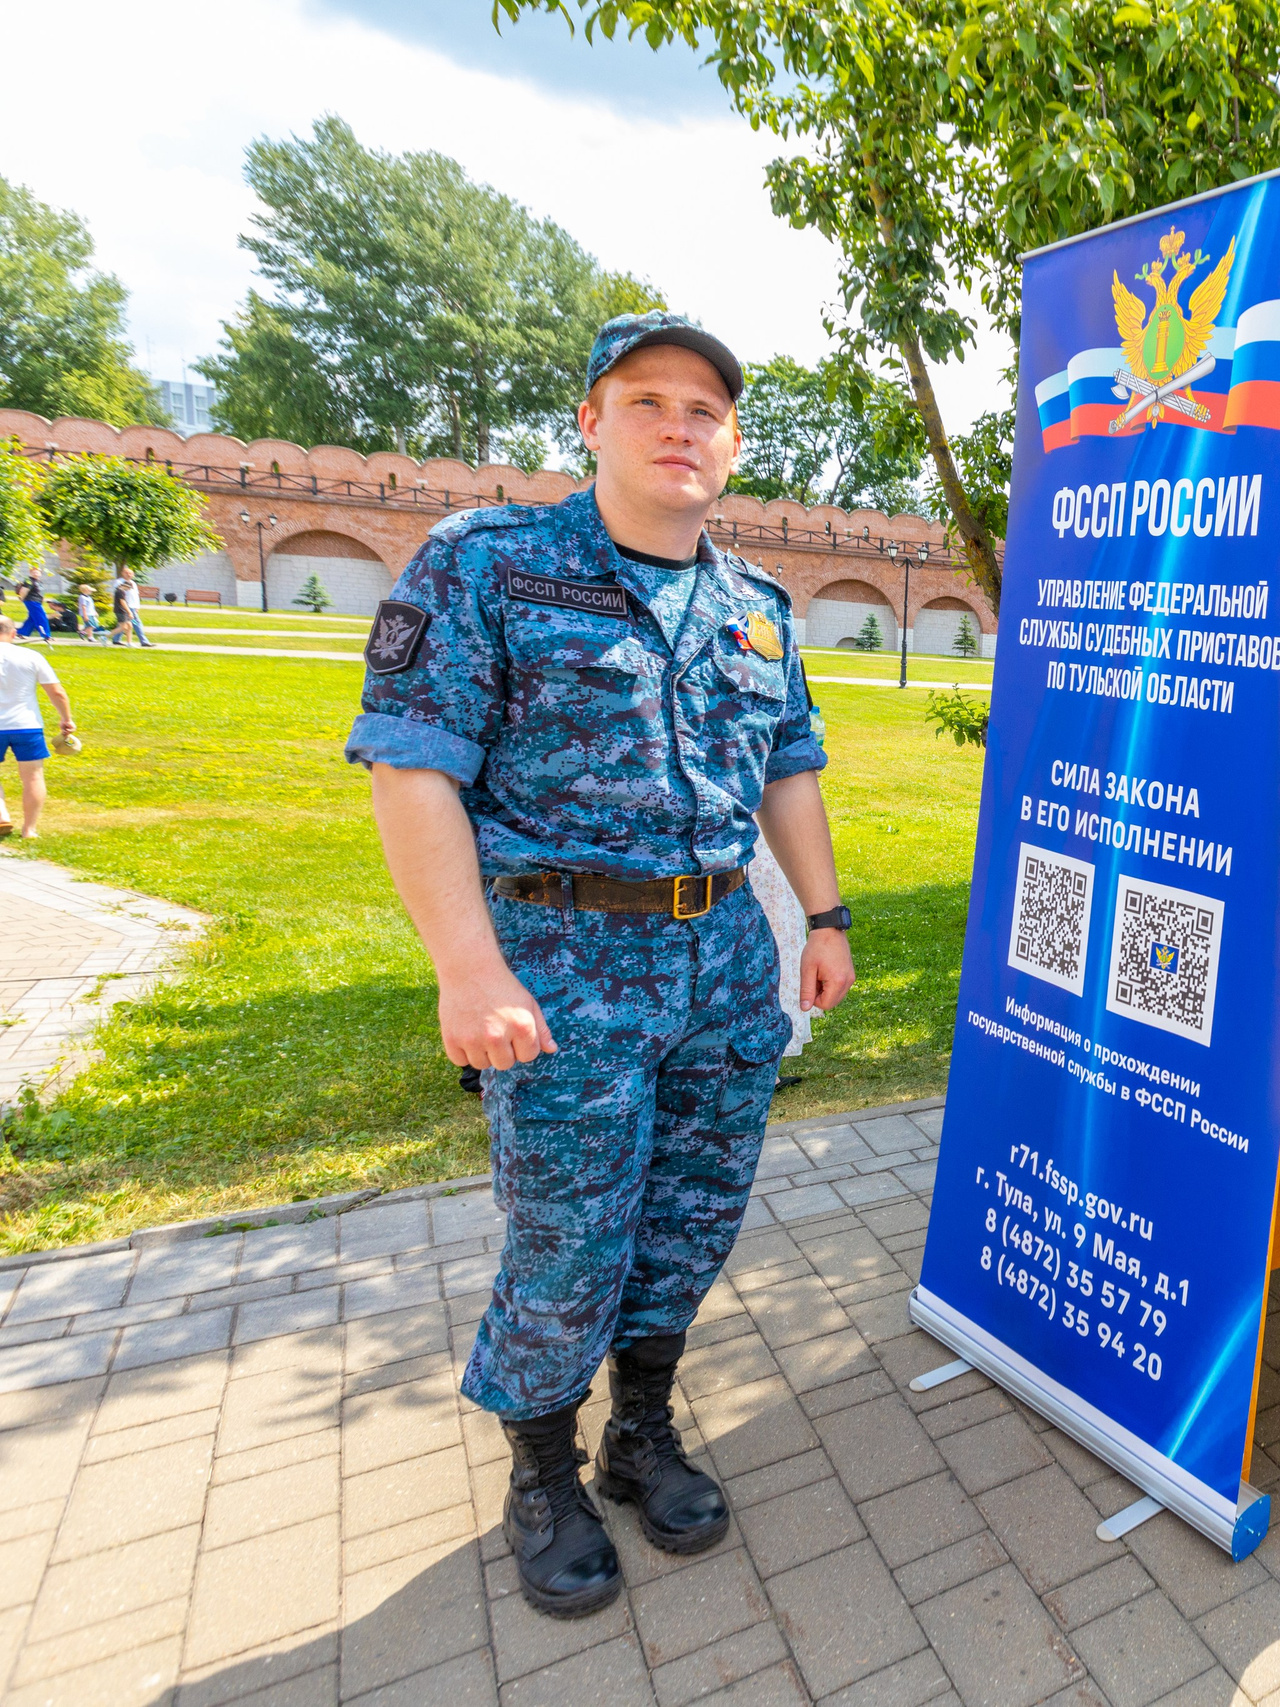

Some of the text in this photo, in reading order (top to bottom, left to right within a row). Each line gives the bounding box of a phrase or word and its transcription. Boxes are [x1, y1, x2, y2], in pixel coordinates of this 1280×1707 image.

[1052, 474, 1262, 539] ФССП РОССИИ
[512, 576, 623, 608] ФССП РОССИИ
[1037, 579, 1268, 620] УПРАВЛЕНИЕ ФЕДЕРАЛЬНОЙ
[1019, 617, 1083, 651] СЛУЖБЫ
[1085, 623, 1172, 660] СУДЕБНЫХ
[1046, 660, 1235, 714] ПО ТУЛЬСКОЙ ОБЛАСТИ
[1051, 759, 1200, 818] СИЛА ЗАКОНА
[1021, 795, 1233, 876] В ЕГО ИСПОЛНЕНИИ
[968, 1011, 1249, 1154] государственной службы в ФССП России
[1005, 996, 1201, 1098] Информация о прохождении
[1010, 1143, 1154, 1241] r71.fssp.gov.ru
[976, 1167, 1190, 1307] г. Тула, ул. 9 Мая, д.1
[985, 1208, 1167, 1337] 8 (4872) 35 57 79
[980, 1246, 1162, 1381] 8 (4872) 35 94 20
